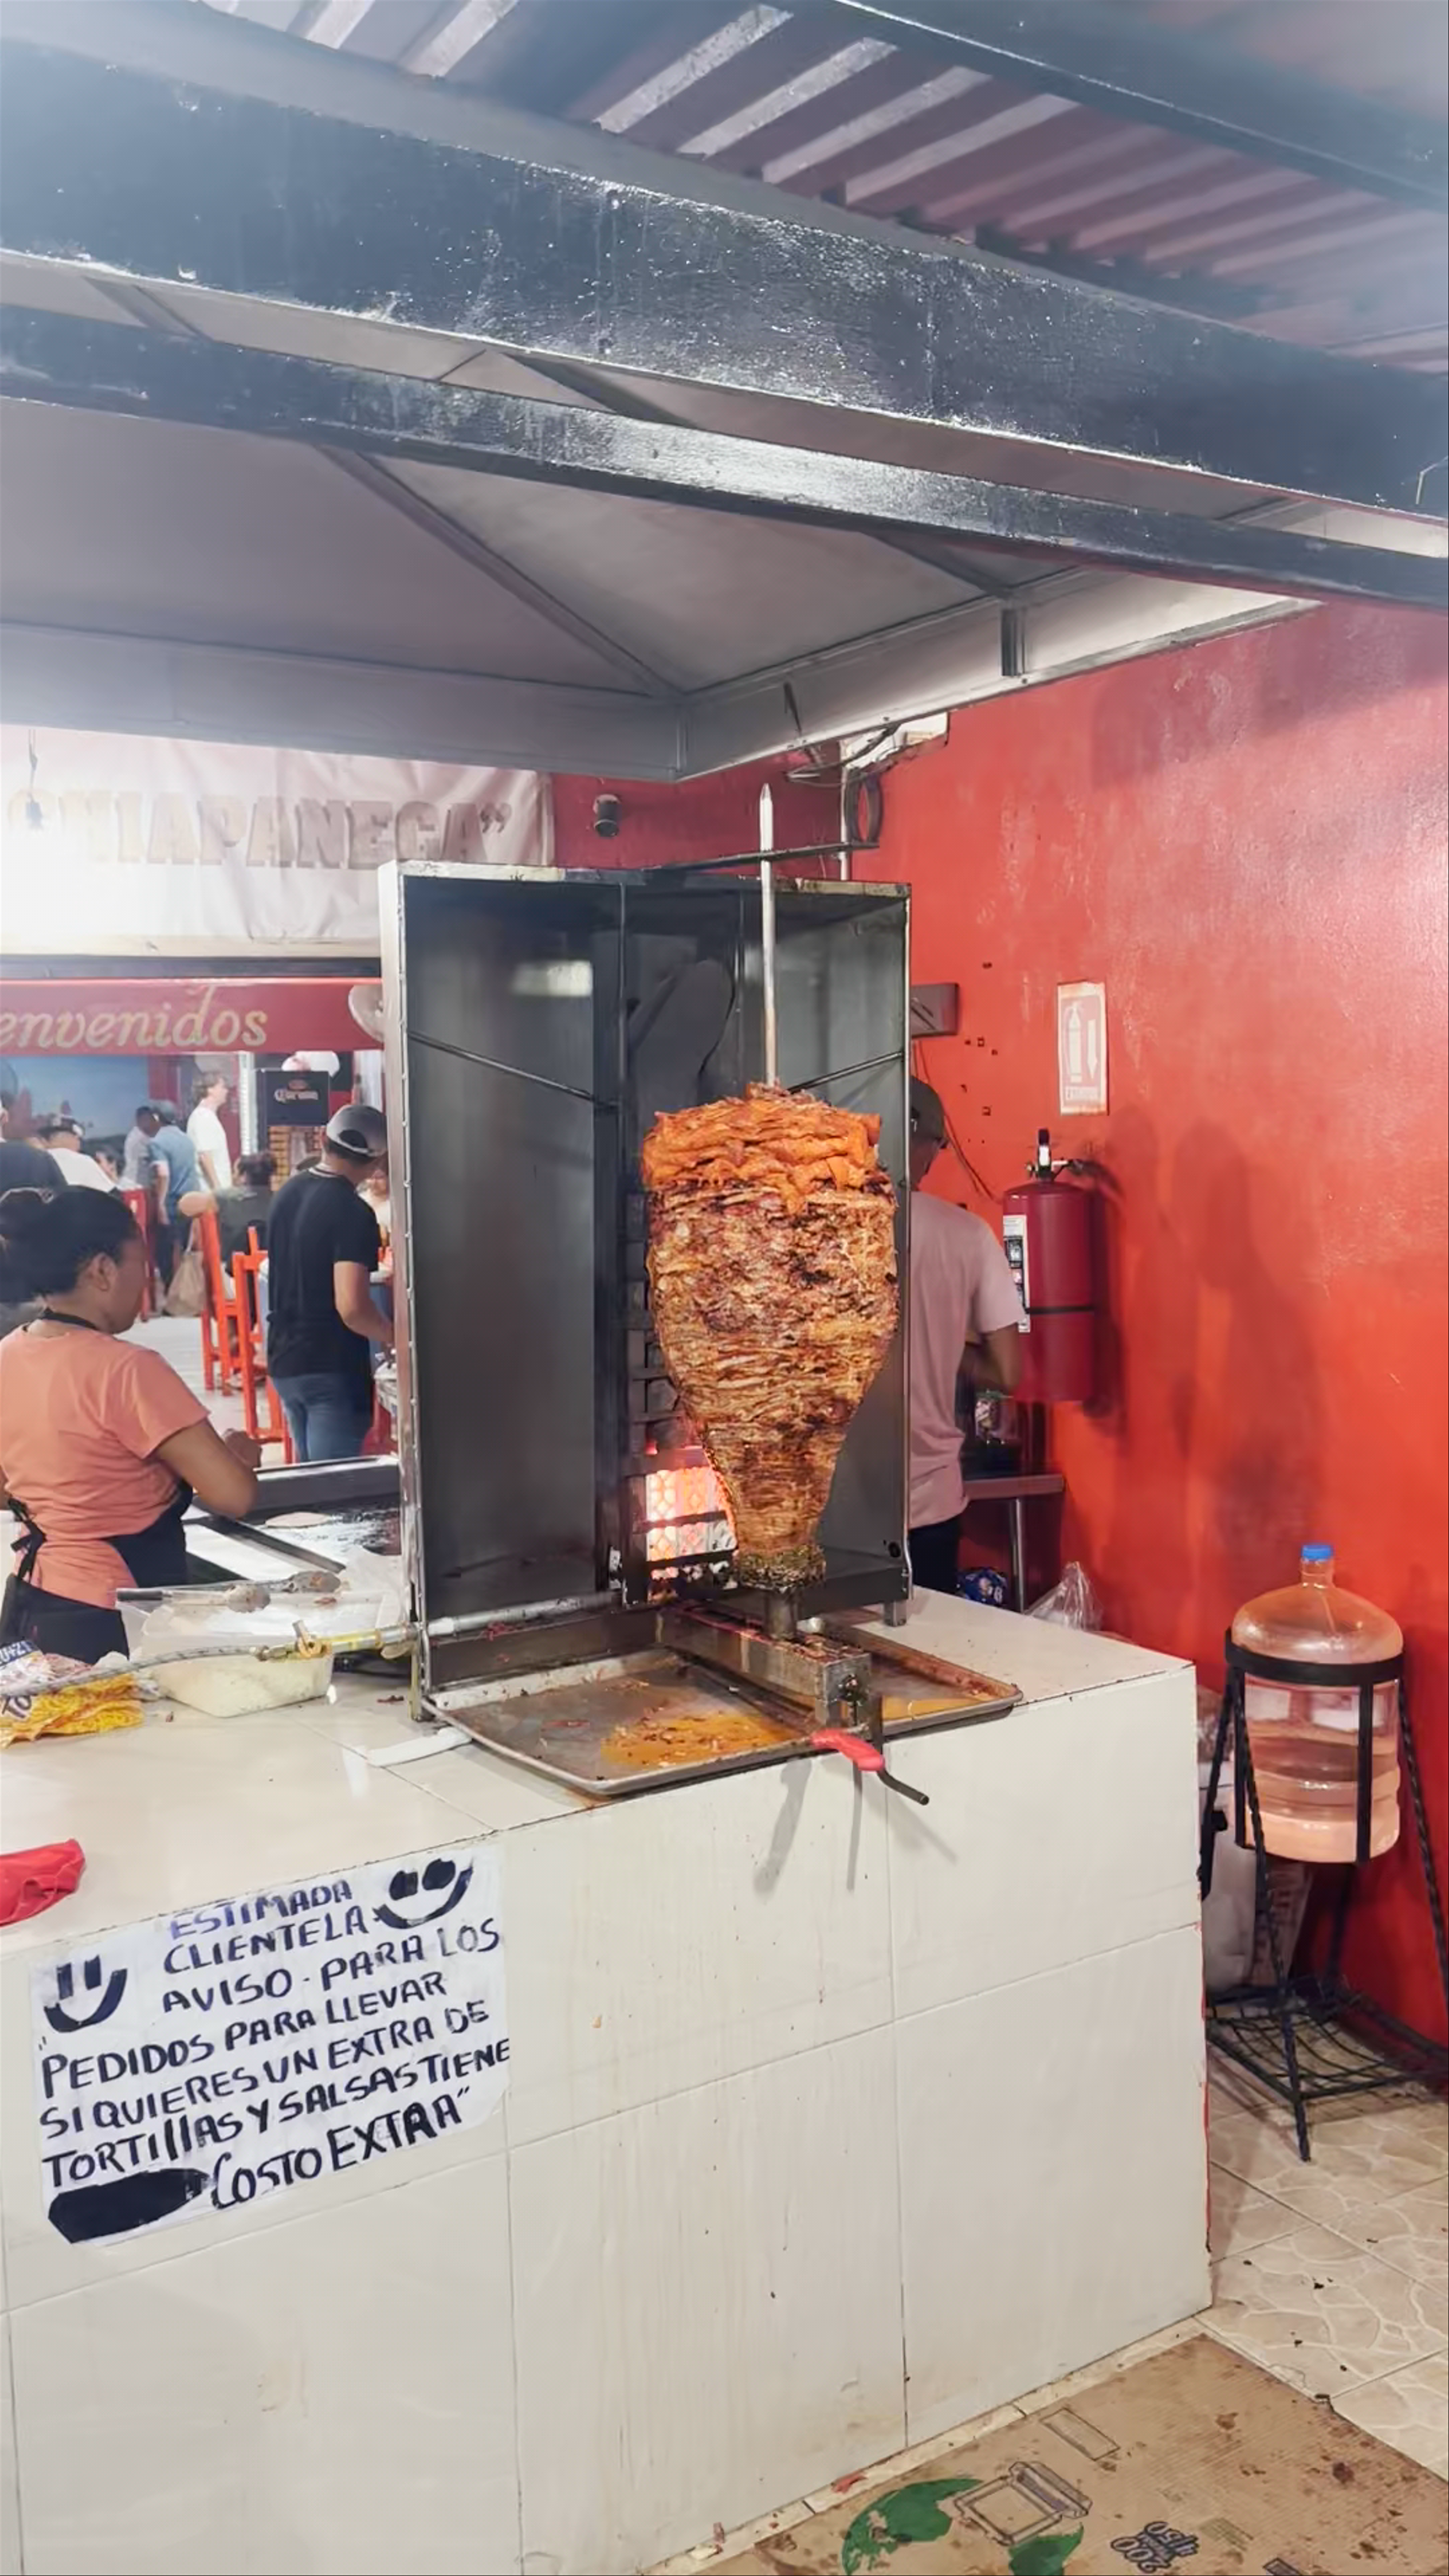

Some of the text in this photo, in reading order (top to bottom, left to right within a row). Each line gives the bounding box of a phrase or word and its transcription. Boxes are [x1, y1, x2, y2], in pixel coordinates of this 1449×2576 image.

[163, 1905, 369, 1974] CLIENTELA
[170, 1879, 352, 1939] ESTIMADA
[162, 1968, 292, 2013] AVISO
[321, 1935, 424, 1991] PARA
[437, 1918, 500, 1957] LOS
[225, 2009, 316, 2050] PARA
[326, 1971, 447, 2025] LLEVAR
[40, 2000, 489, 2139] SI QUIERES UN EXTRA DE
[246, 2099, 269, 2133] Y
[211, 2148, 322, 2210] COSTO
